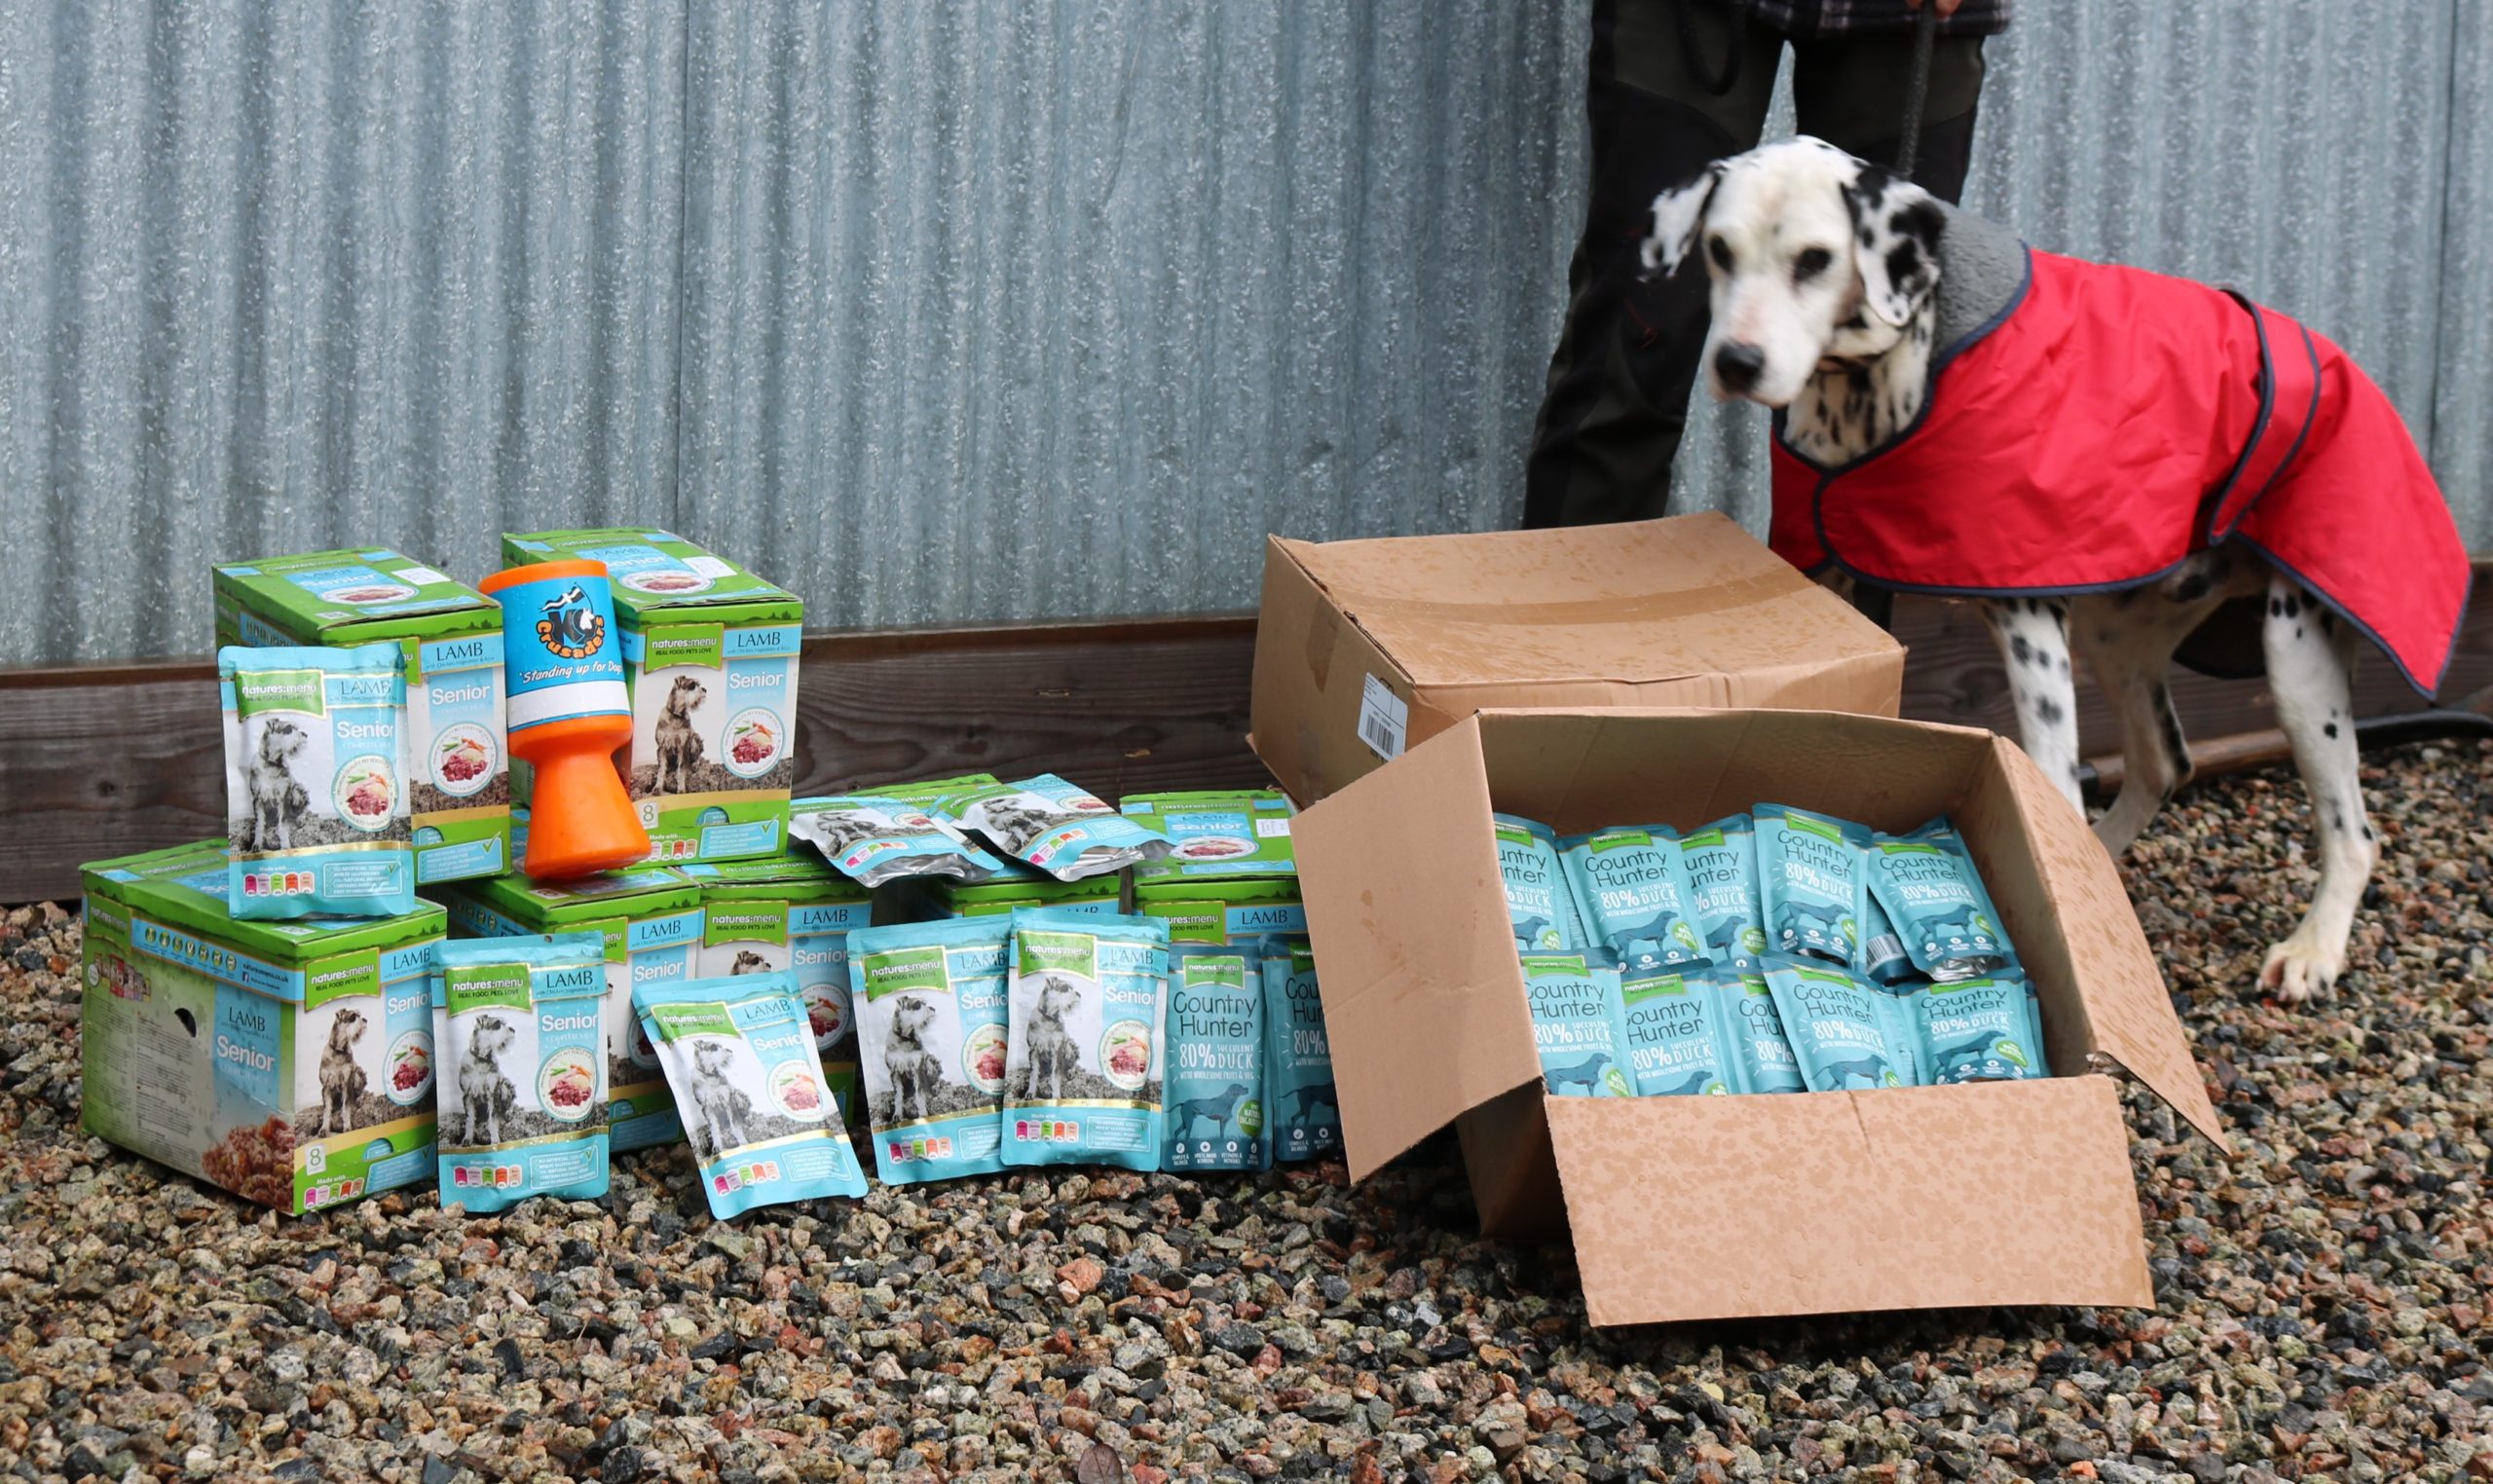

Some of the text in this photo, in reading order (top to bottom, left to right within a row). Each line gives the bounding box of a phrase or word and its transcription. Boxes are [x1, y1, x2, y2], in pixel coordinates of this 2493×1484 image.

[536, 615, 605, 659] Crusaders
[651, 631, 781, 649] natures:menu LAMB
[436, 642, 483, 661] LAMB
[576, 665, 589, 674] up
[592, 661, 606, 672] for
[242, 680, 391, 695] natures:menu LAMB
[729, 672, 784, 689] Senior
[431, 685, 490, 705] Senior
[337, 721, 393, 738] Senior
[643, 804, 654, 822] 8
[1172, 823, 1244, 832] Senior
[1777, 830, 1853, 868] Country
[1499, 849, 1546, 870] untry
[1585, 850, 1666, 872] Country
[1684, 850, 1739, 872] untry
[1785, 844, 1852, 877] Hunter
[1879, 856, 1956, 871] Country
[1500, 865, 1546, 883] nter
[1594, 867, 1669, 887] Hunter
[1785, 862, 1820, 888] 80%
[1891, 869, 1962, 882] Hunter
[1517, 891, 1551, 908] DUCK
[1600, 890, 1640, 909] 80%
[1640, 888, 1678, 905] DUCK
[1711, 891, 1747, 906] DUCK
[1821, 879, 1854, 902] DUCK
[1899, 884, 1939, 900] 80%
[1939, 887, 1975, 899] DUCK
[712, 909, 848, 924] natures:menu LAMB
[1165, 909, 1287, 925] tures:menu LAMB
[641, 919, 681, 940] LAMB
[794, 947, 847, 965] Senior
[872, 952, 1006, 977] natures:menu LAMB
[1025, 945, 1154, 964] natures:menu LAMB
[312, 964, 375, 984] natures:menu
[393, 947, 430, 970] LAMB
[634, 960, 684, 982] Senior
[316, 983, 328, 991] REAL
[345, 978, 357, 986] PETS
[357, 975, 369, 983] LOVE
[453, 970, 593, 991] natures:menu LAMB
[961, 992, 1007, 1011] Senio
[1173, 991, 1257, 1019] Country
[1794, 984, 1870, 1012] Country
[1920, 989, 2007, 1009] Country
[229, 1006, 265, 1032] LAMB
[663, 999, 791, 1023] natures:menu LAMB
[1528, 1000, 1605, 1019] Hunter
[1805, 1000, 1874, 1024] Hunter
[1929, 999, 2005, 1020] Hunter
[541, 1011, 597, 1032] Senior
[1180, 1014, 1253, 1038] Hunter
[1811, 1020, 1853, 1040] 80%
[1931, 1019, 1970, 1034] 80%
[1971, 1015, 2010, 1027] DUCK
[753, 1033, 803, 1052] Senio
[1293, 1029, 1325, 1055] 80%
[1534, 1022, 1573, 1044] 80%
[1575, 1028, 1613, 1044] DUCK
[1626, 1019, 1704, 1046] Hunter
[1853, 1027, 1885, 1050] DUCK
[217, 1035, 276, 1071] Senior
[1179, 1043, 1254, 1068] 80% SUCCULENT
[1218, 1053, 1253, 1069] DUCK
[1631, 1036, 1710, 1070] 80% SUCCULENT
[1673, 1043, 1713, 1063] DUCK
[1755, 1040, 1794, 1062] 80%
[1180, 1070, 1193, 1080] WITH
[310, 1148, 321, 1167] 8
